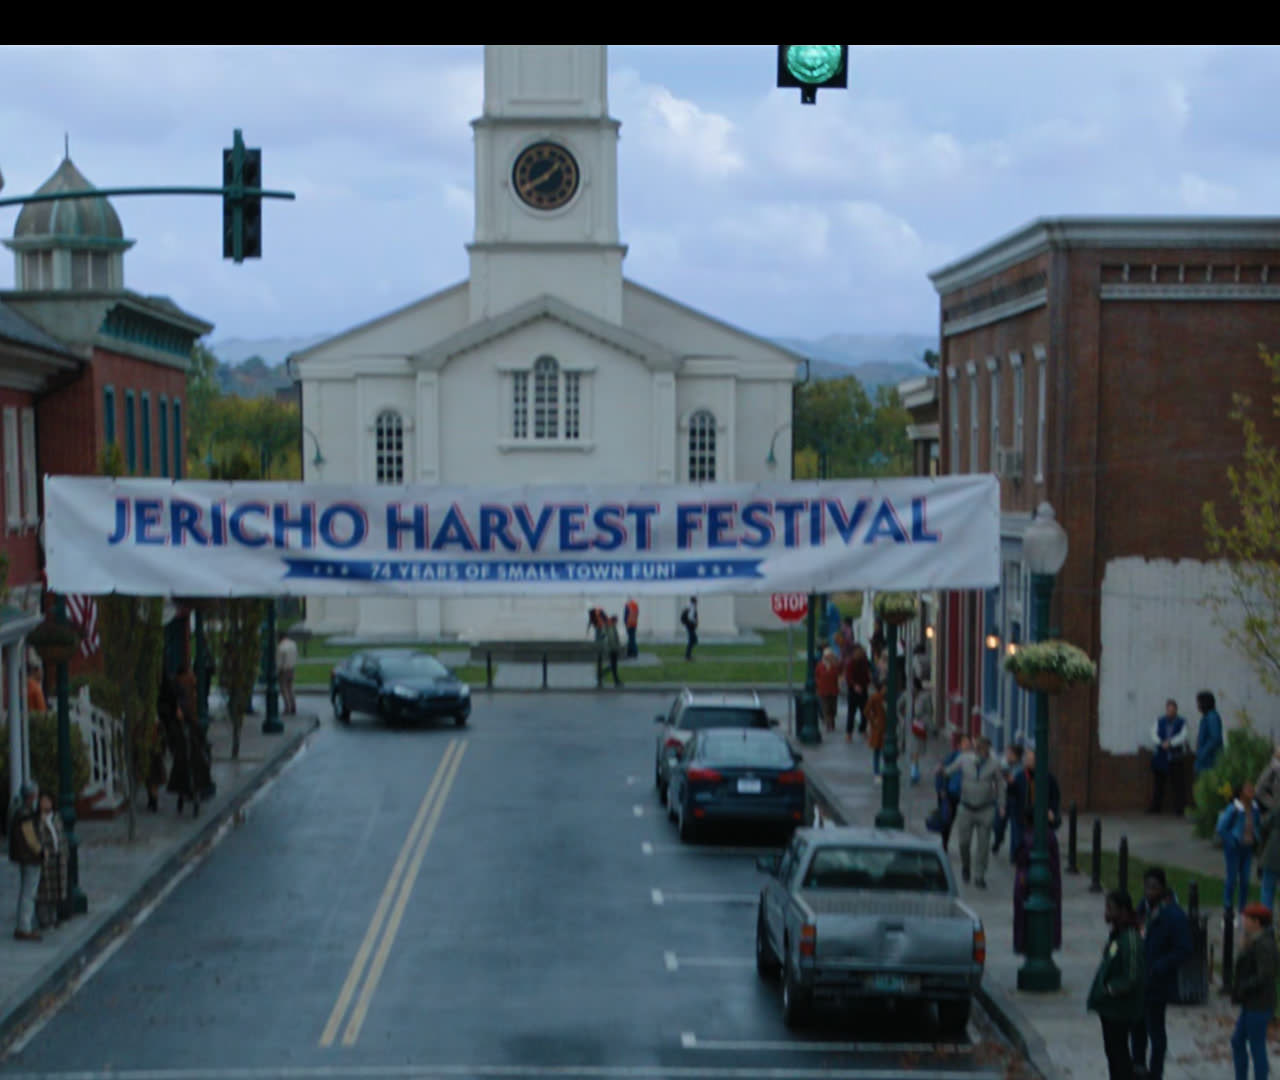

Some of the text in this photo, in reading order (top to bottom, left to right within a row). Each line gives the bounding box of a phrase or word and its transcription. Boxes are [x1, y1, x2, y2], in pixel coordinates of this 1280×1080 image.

[108, 496, 941, 552] JERICHO HARVEST FESTIVAL
[371, 562, 676, 579] 74 YEARS OF SMALL TOWN FUN!
[773, 594, 808, 610] STOP
